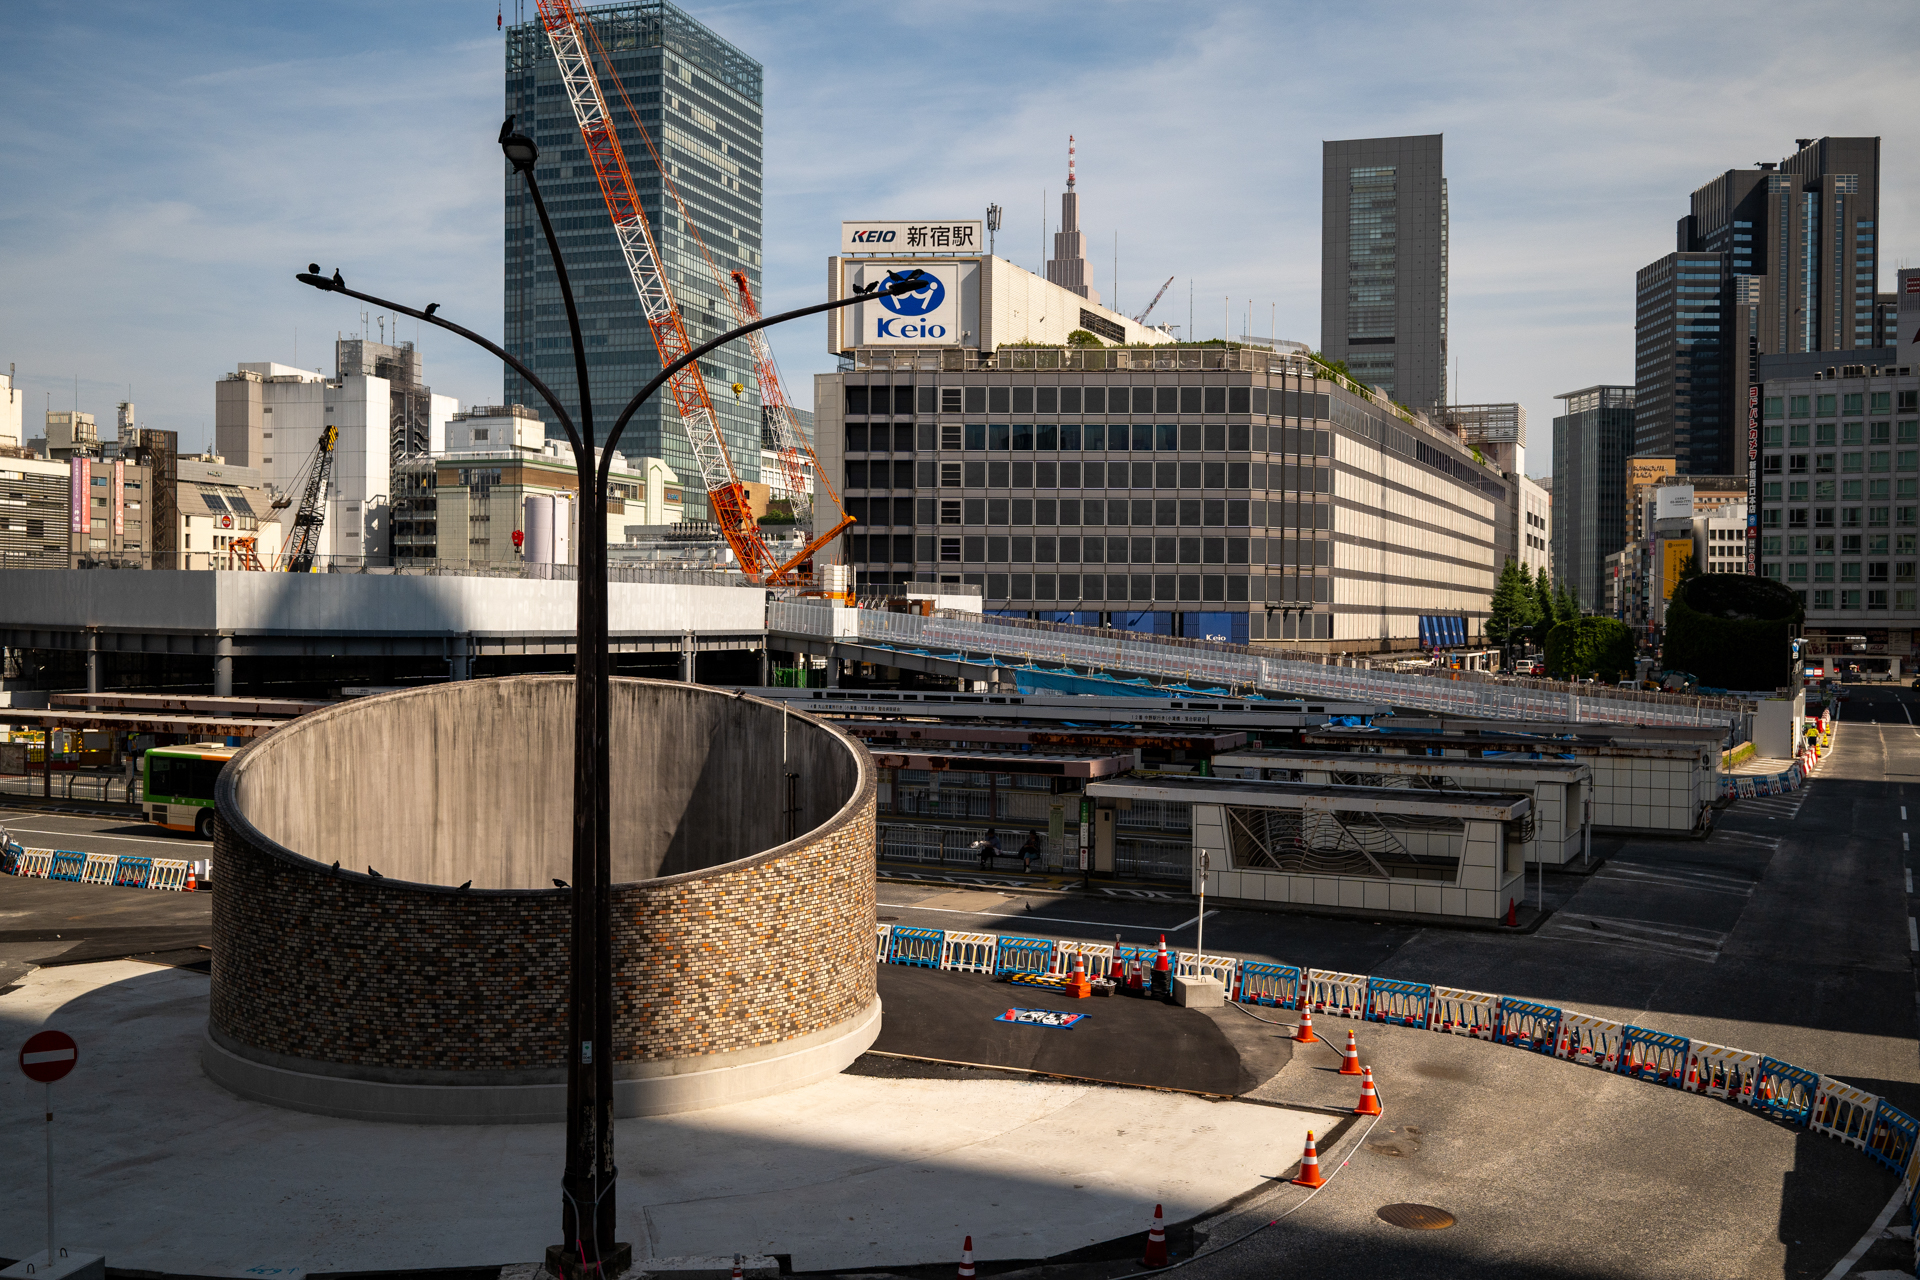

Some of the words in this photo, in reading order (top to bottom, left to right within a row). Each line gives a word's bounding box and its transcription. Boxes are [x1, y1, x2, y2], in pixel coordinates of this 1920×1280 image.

[852, 230, 896, 242] KEIO
[907, 226, 973, 247] 新宿駅
[877, 318, 946, 338] Keio
[1748, 386, 1759, 461] ヨドバシカメラ
[1748, 460, 1757, 514] 新宿西口本店
[1206, 633, 1227, 642] Keio
